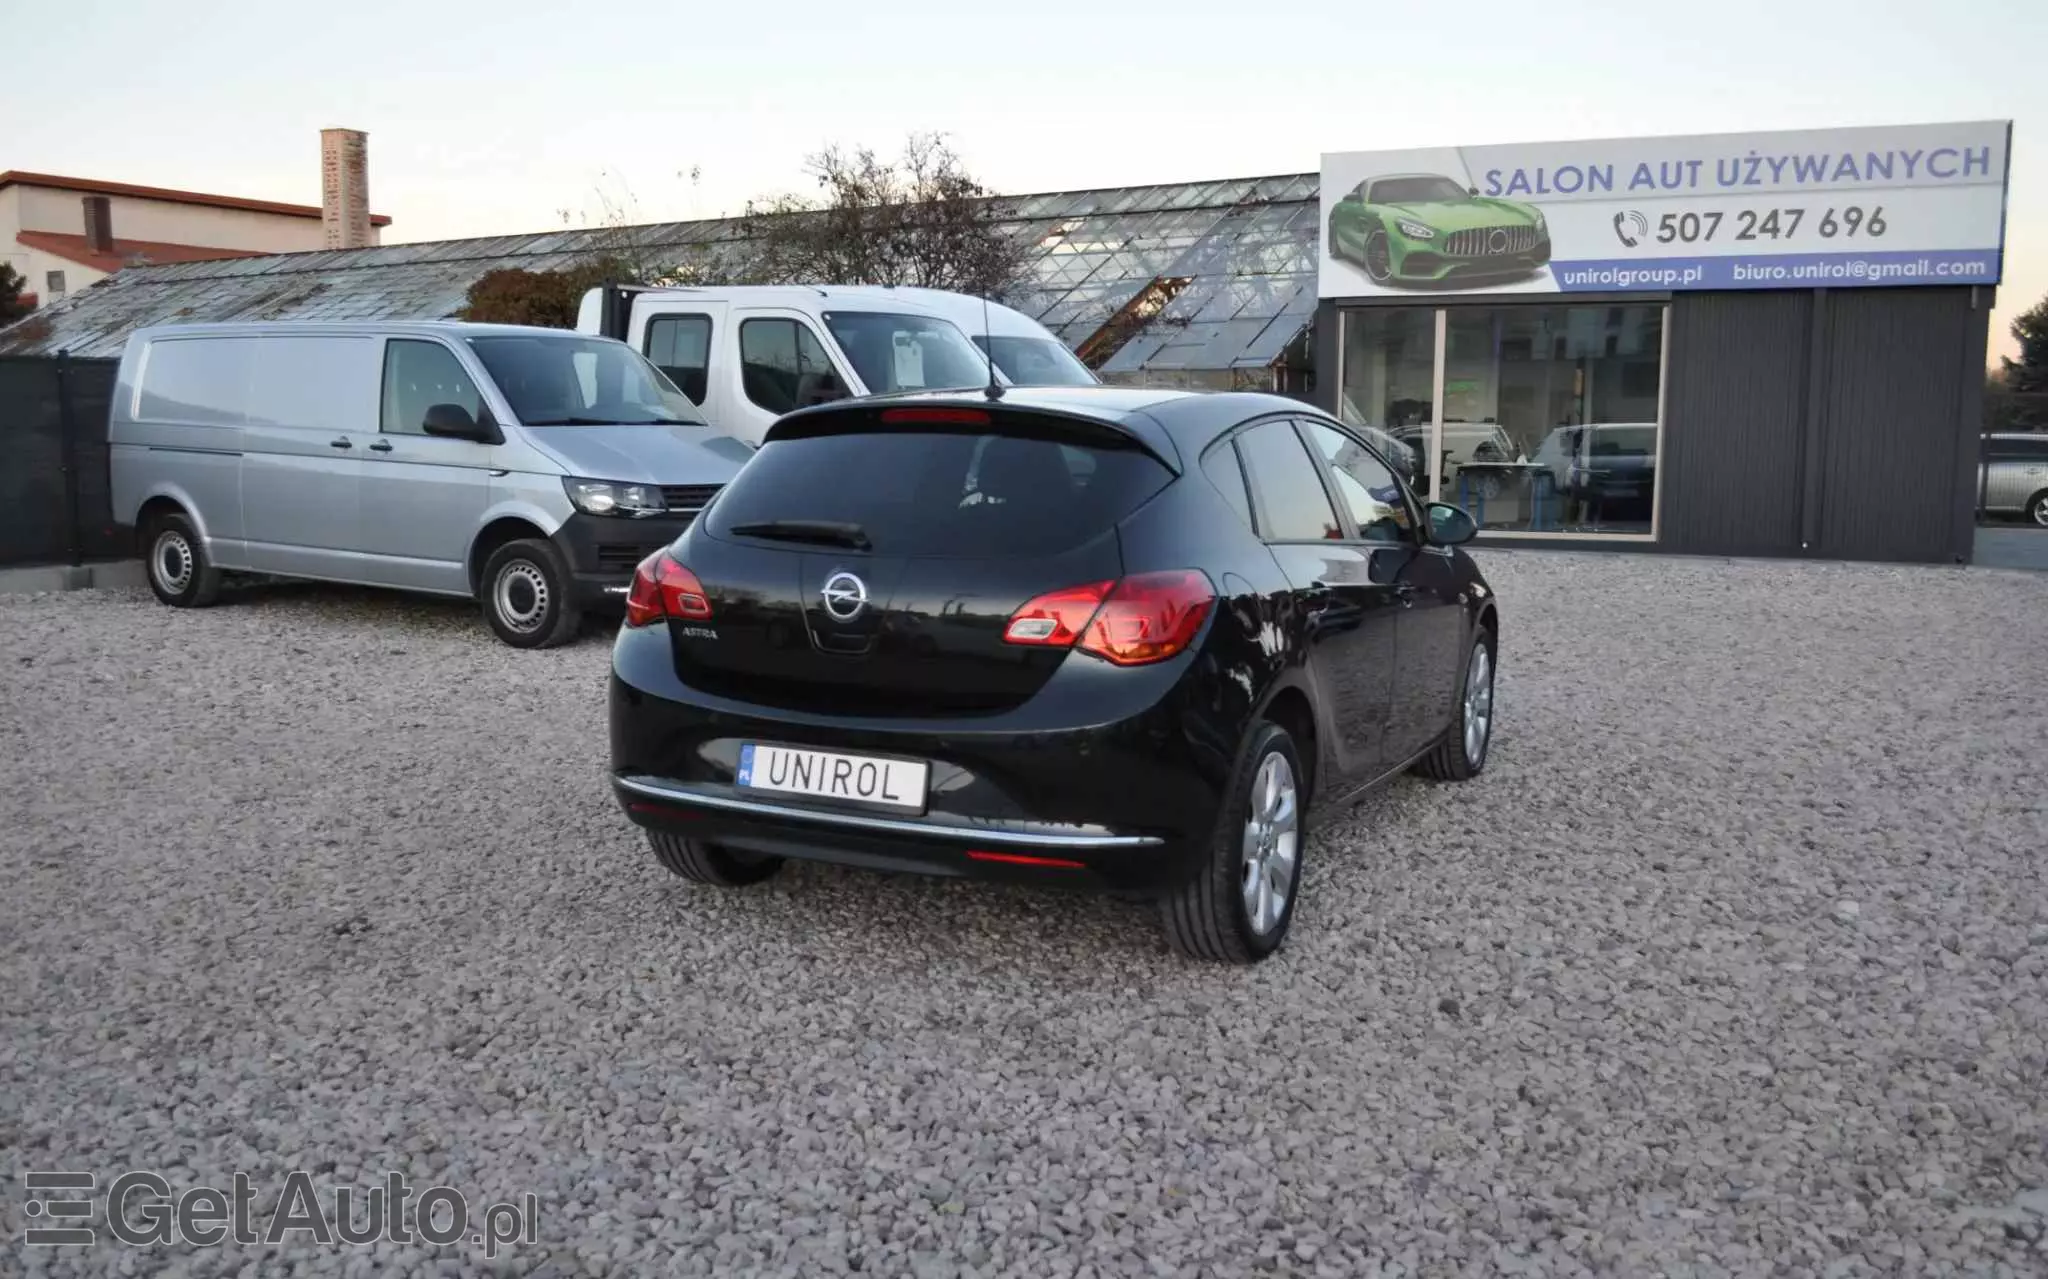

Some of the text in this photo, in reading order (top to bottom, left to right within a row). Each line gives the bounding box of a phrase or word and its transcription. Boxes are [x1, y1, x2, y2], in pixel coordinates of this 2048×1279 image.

[1485, 147, 1990, 197] SALON AUT UŻYWANYCH
[1656, 206, 1887, 244] 507 247 696
[1564, 266, 1703, 289] unirolgroup.pl
[1733, 259, 1986, 281] biuro.unirol@gmail.com
[769, 751, 899, 801] UNIROL
